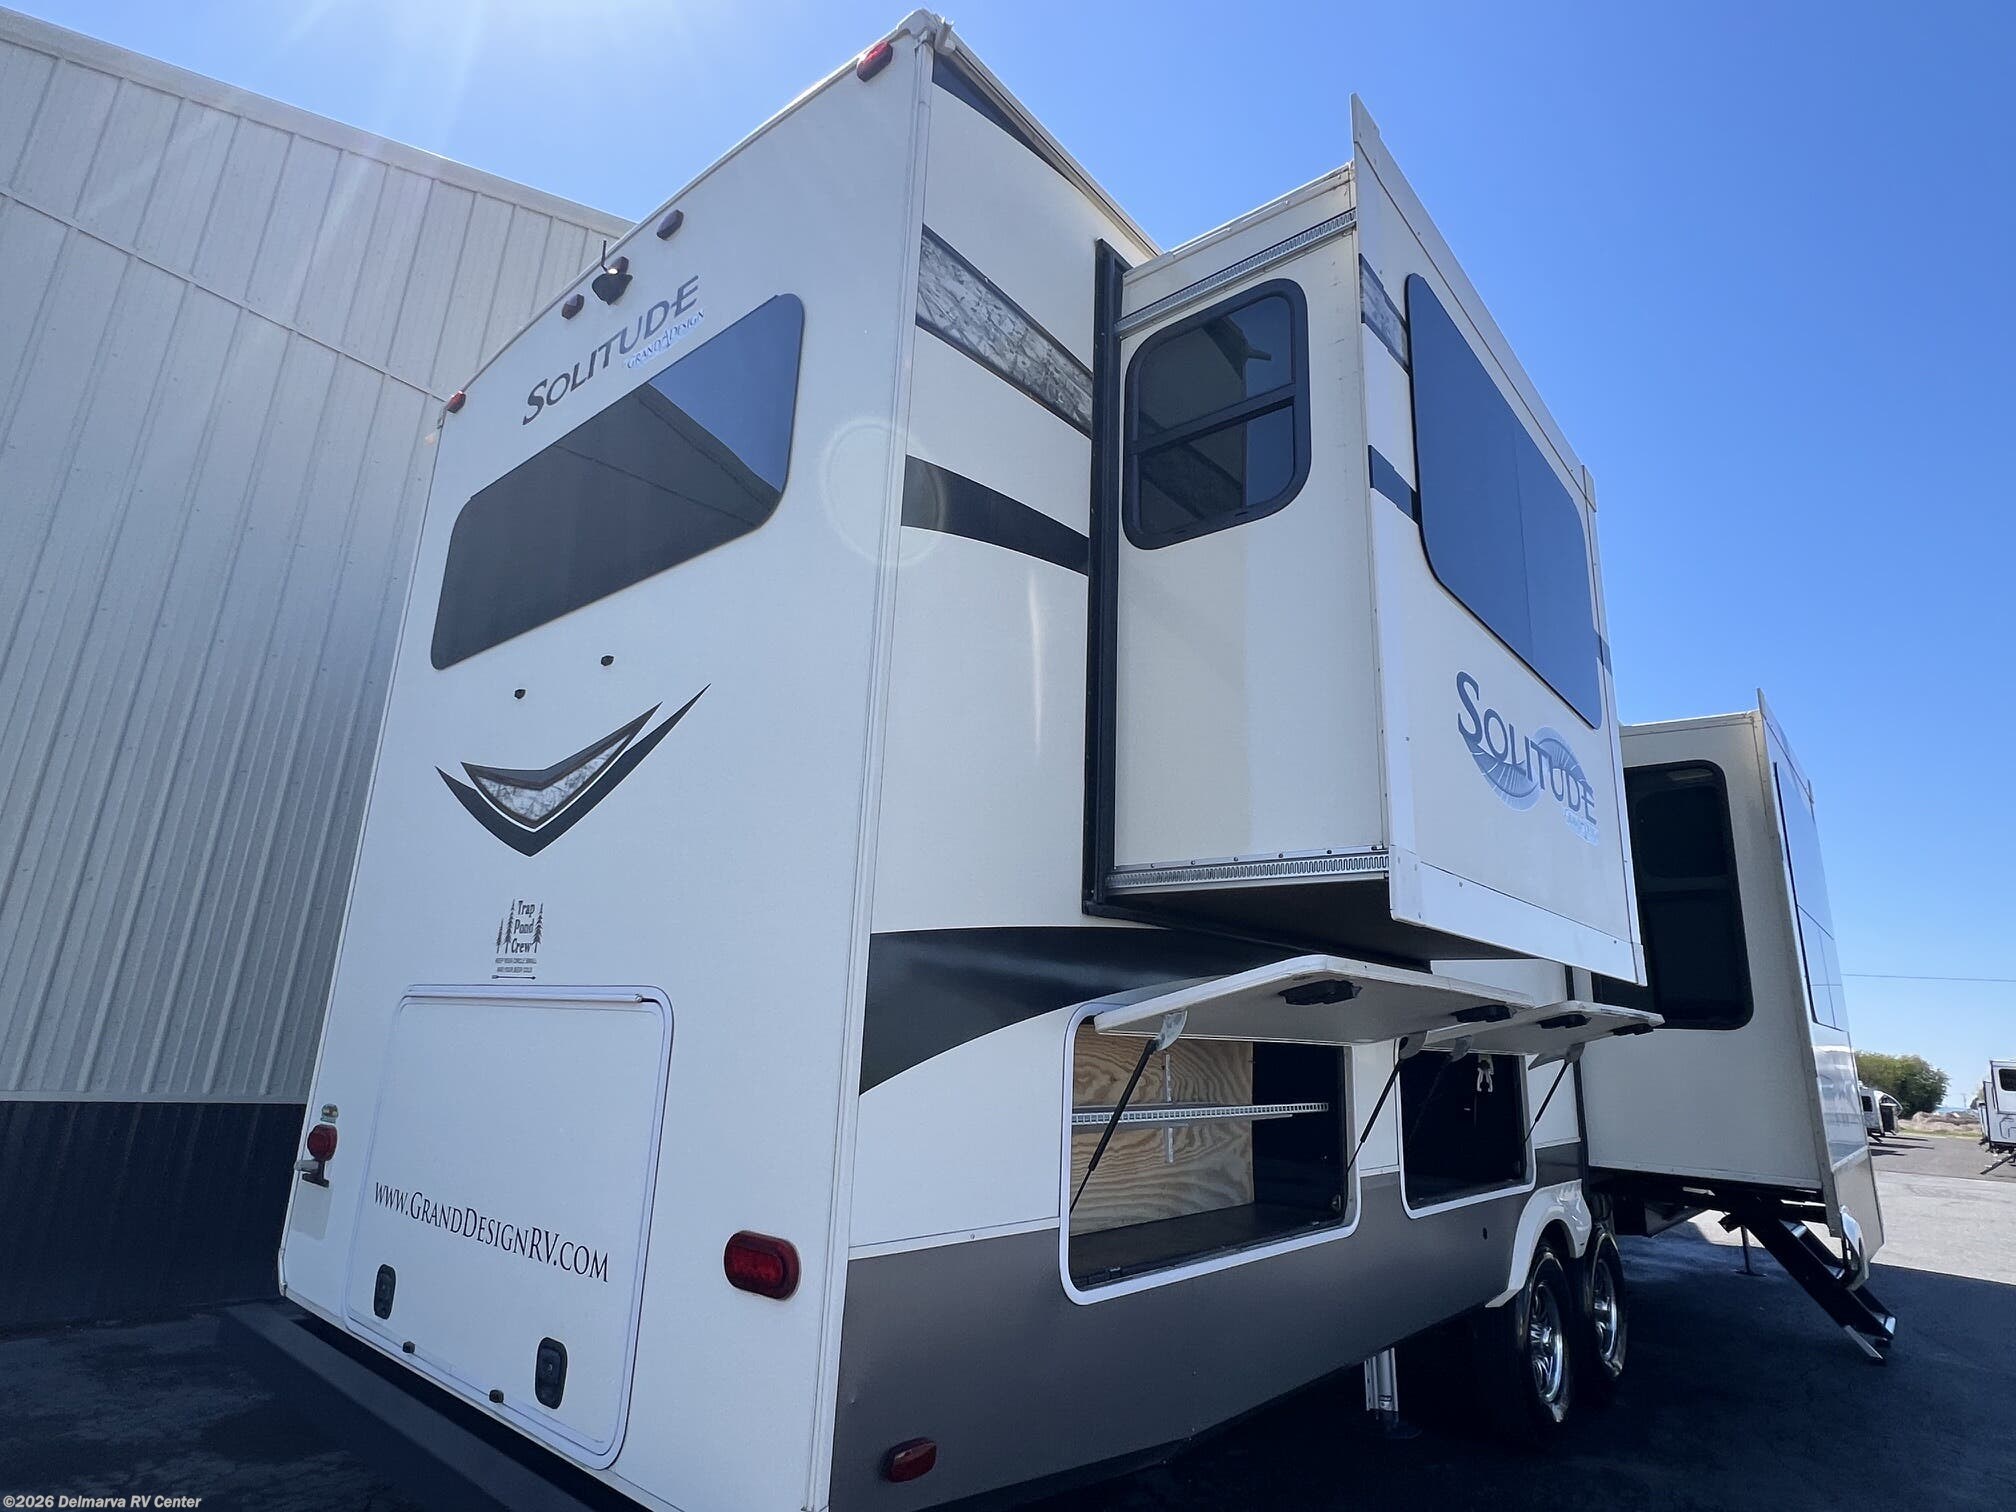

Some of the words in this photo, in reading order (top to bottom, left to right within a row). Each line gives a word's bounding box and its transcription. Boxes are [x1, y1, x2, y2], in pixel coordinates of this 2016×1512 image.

[522, 275, 699, 425] SOLITUDE
[1456, 671, 1597, 825] SOLITUDE
[517, 900, 535, 918] Trap
[513, 918, 535, 934] Pond
[511, 938, 532, 953] Crew
